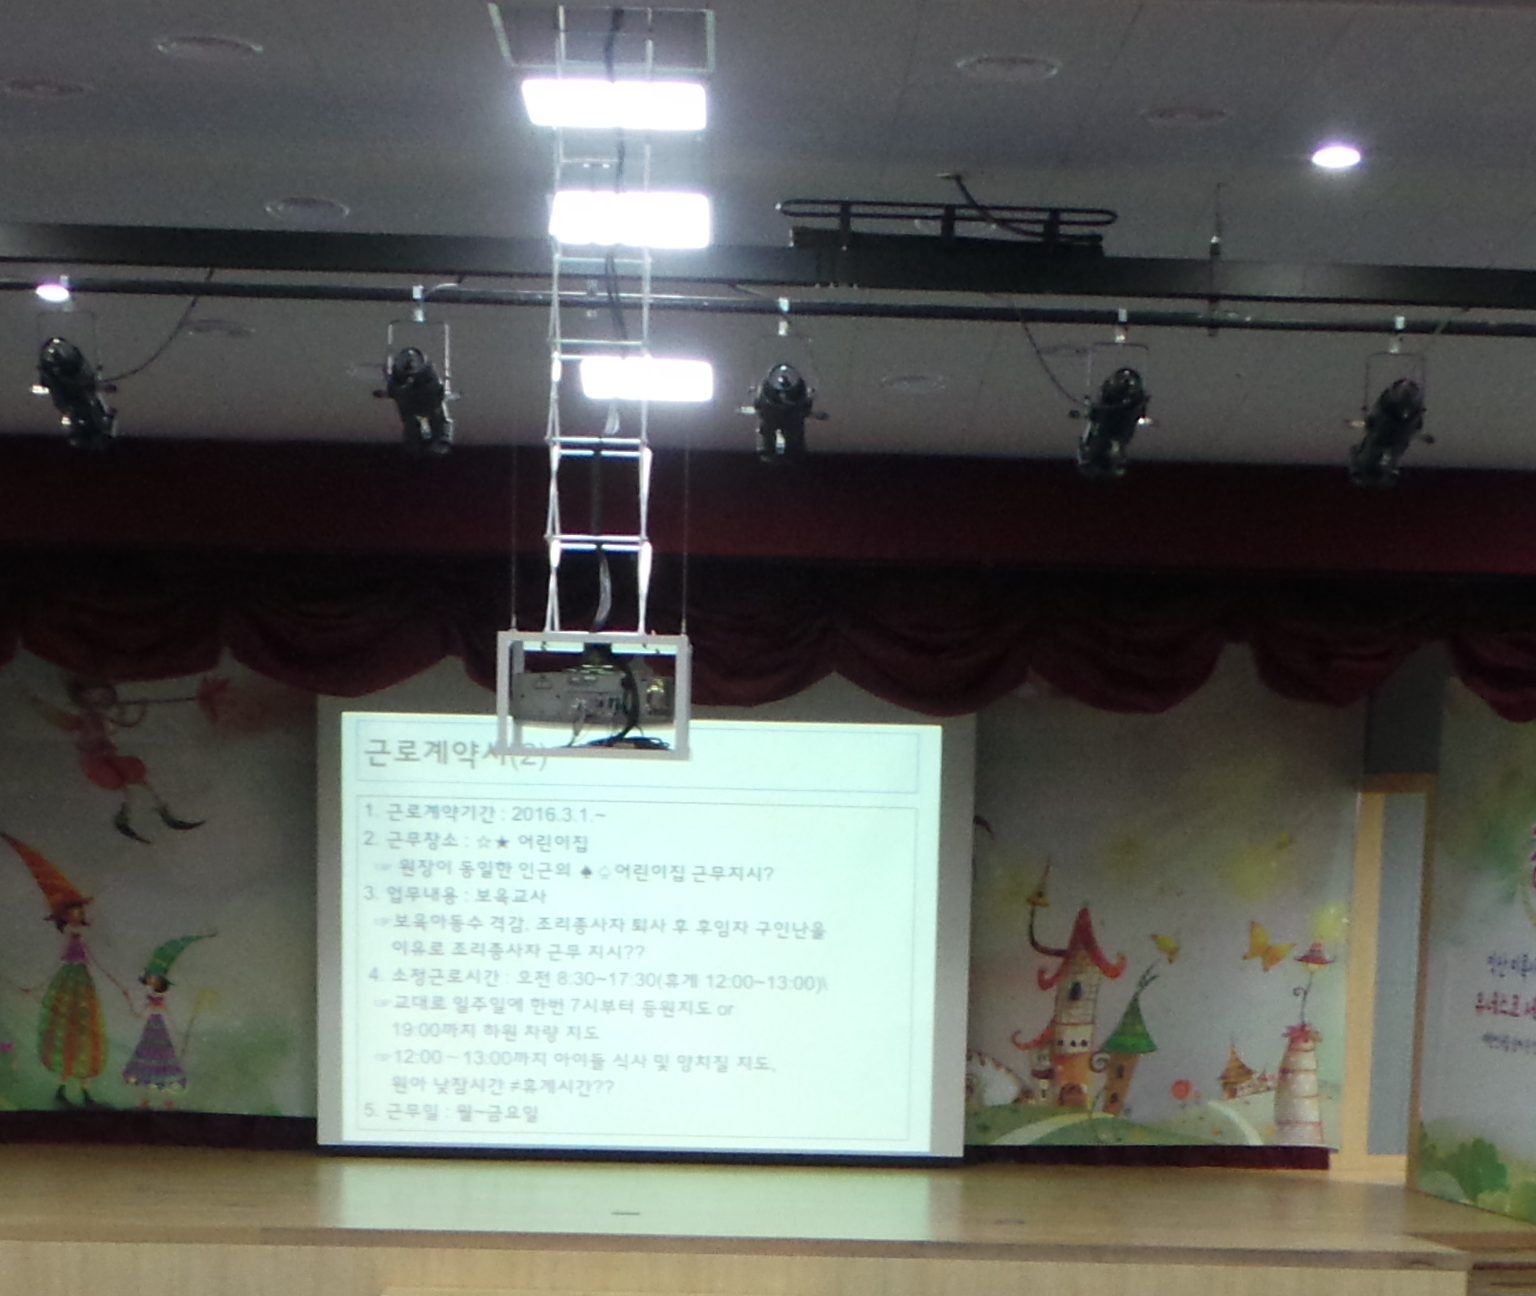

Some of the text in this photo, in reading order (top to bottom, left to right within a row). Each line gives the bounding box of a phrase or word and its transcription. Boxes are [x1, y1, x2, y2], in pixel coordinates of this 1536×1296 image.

[387, 803, 496, 824] 근로계약기간
[387, 831, 459, 850] 근무장소
[518, 834, 589, 853] 어린이집
[399, 859, 453, 878] 원장이
[459, 860, 512, 880] 동일한
[518, 862, 572, 881] 인근의
[387, 884, 459, 905] 업무내용
[476, 887, 548, 906] 보육교사
[393, 913, 484, 933] 보육아동수
[536, 915, 625, 936] 조리종사자
[631, 917, 667, 934] 퇴사
[672, 918, 690, 935] 후
[695, 919, 750, 939] 후임자
[754, 920, 827, 941] 구인난을
[391, 940, 446, 957] 이유로
[451, 941, 541, 962] 조리종사자
[546, 943, 582, 962] 근무
[391, 967, 501, 988] 소정근로시간
[516, 969, 552, 989] 오전
[394, 995, 448, 1011] 교대로
[530, 997, 566, 1016] 한번
[571, 998, 635, 1016] 7시부터
[641, 999, 713, 1019] 등원지도
[483, 1024, 518, 1042] 하원
[524, 1024, 560, 1043] 차량
[565, 1025, 601, 1041] 지도
[612, 1053, 648, 1072] 식사
[653, 1053, 670, 1073] 및
[676, 1054, 730, 1074] 양치질
[432, 1076, 504, 1096] 낮잠시간
[386, 1103, 440, 1122] 근무일
